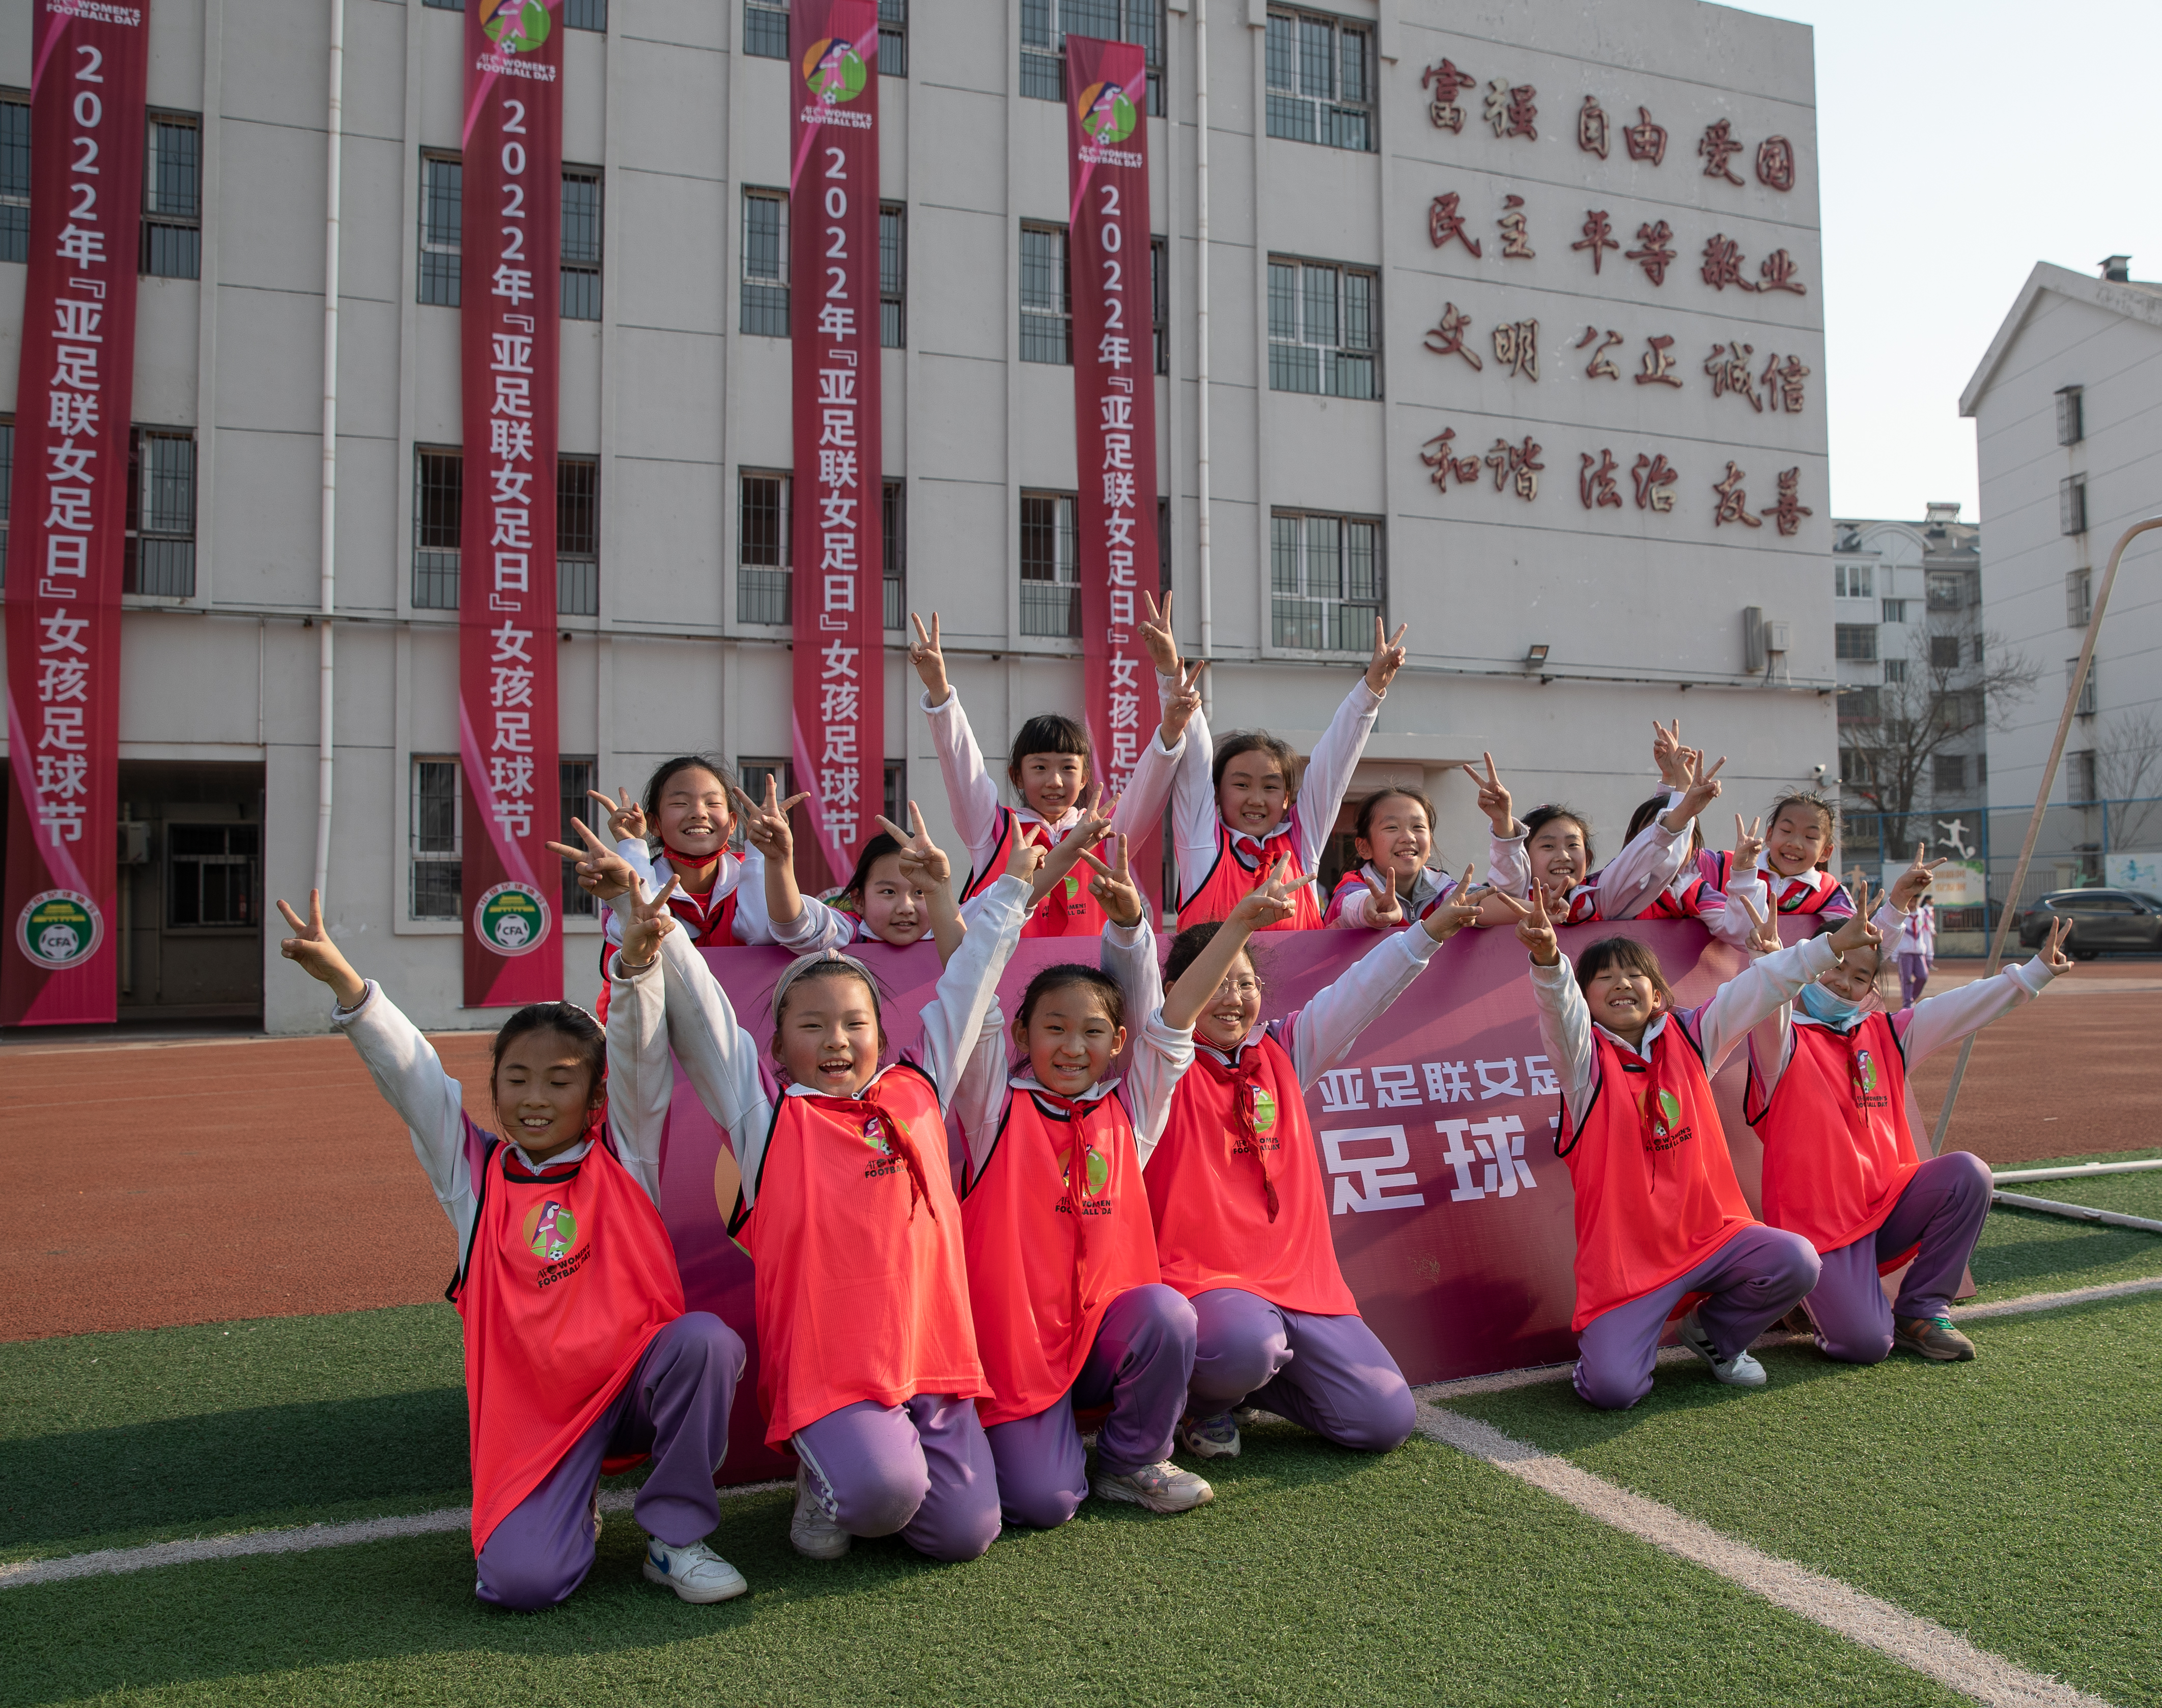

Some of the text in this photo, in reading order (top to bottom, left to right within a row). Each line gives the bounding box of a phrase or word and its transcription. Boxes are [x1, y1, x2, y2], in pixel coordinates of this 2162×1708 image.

[46, 4, 141, 27] FOOTBALL DAY
[476, 62, 556, 82] FOOTBALL DAY
[503, 58, 556, 75] WOMEN'S
[800, 115, 873, 130] FOOTBALL DAY
[824, 109, 873, 122] WOMEN'S
[1422, 58, 1796, 192] 富强 自由 爱国
[1078, 153, 1143, 168] FOOTBALL DAY
[1099, 149, 1142, 162] WOMEN'S
[1429, 191, 1807, 296] 民主 平等 敬业
[1424, 301, 1810, 413] 文明 公正 诚信
[1421, 428, 1813, 536] 和谐 法治 友善
[502, 926, 523, 935] CFA
[47, 937, 71, 947] CFA
[1318, 1055, 1561, 1113] 亚足联女足
[1679, 1132, 1692, 1142] DAY
[557, 1242, 590, 1269] WOMEN'S
[538, 1249, 591, 1288] FOOTBALL DAY
